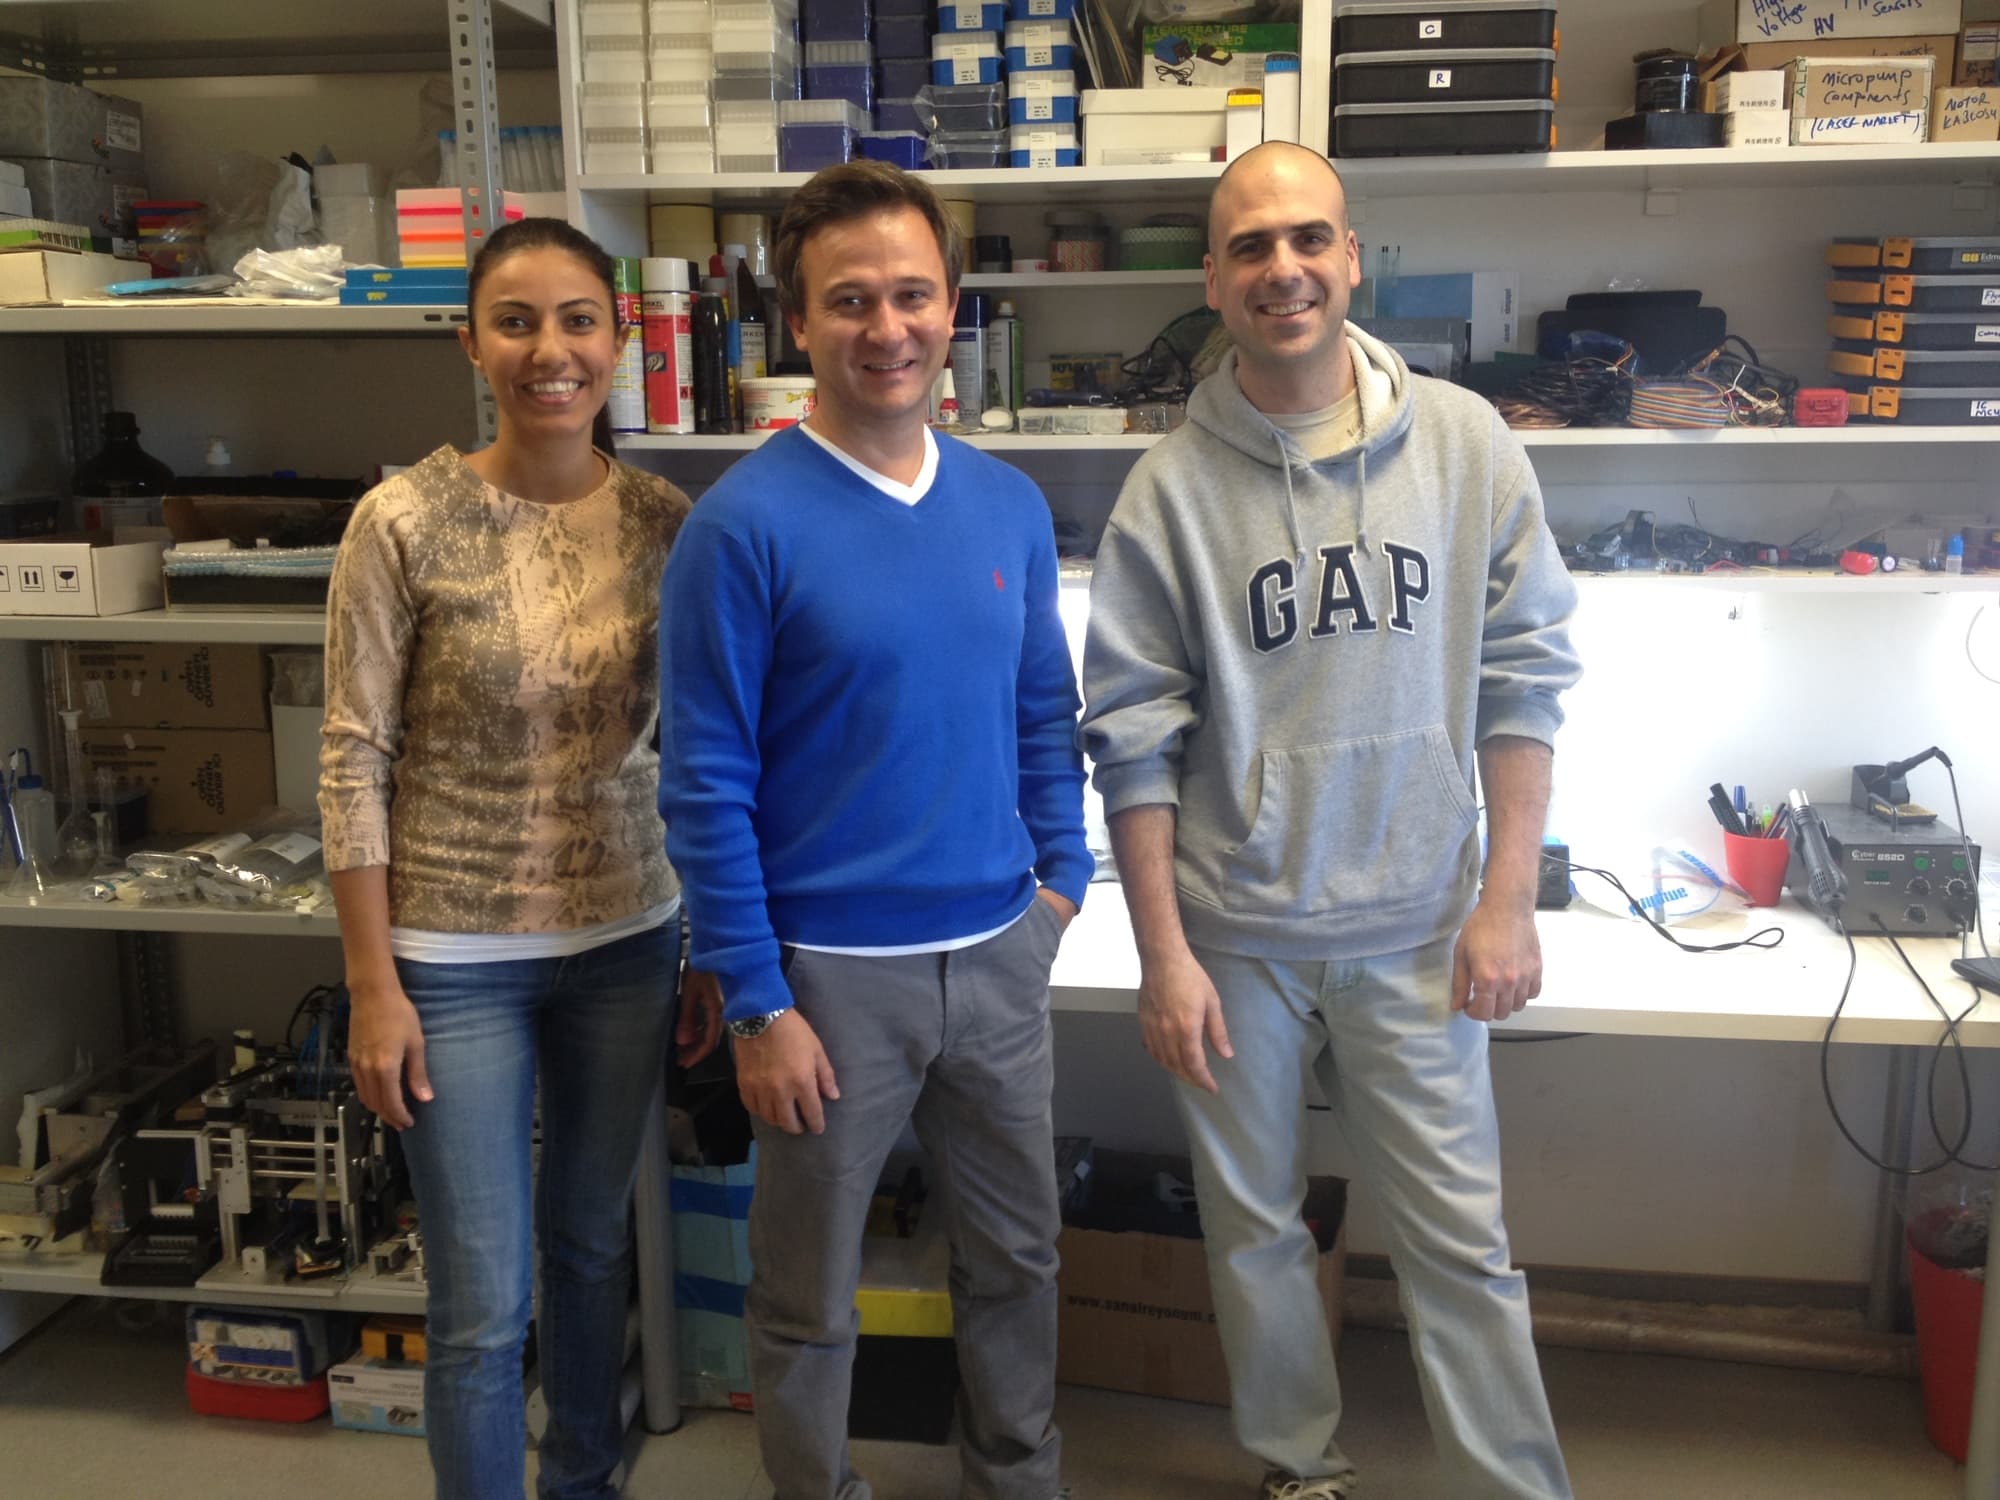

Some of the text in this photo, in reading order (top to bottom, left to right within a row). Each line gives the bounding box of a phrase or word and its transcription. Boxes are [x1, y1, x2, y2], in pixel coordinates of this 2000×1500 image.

[1151, 24, 1248, 36] TEMPERATURE
[1424, 24, 1436, 35] C
[1814, 13, 1835, 36] HV
[1435, 73, 1445, 85] R
[1822, 69, 1912, 93] Micropump
[1944, 92, 1990, 112] MOTOR
[1247, 538, 1431, 655] GAP
